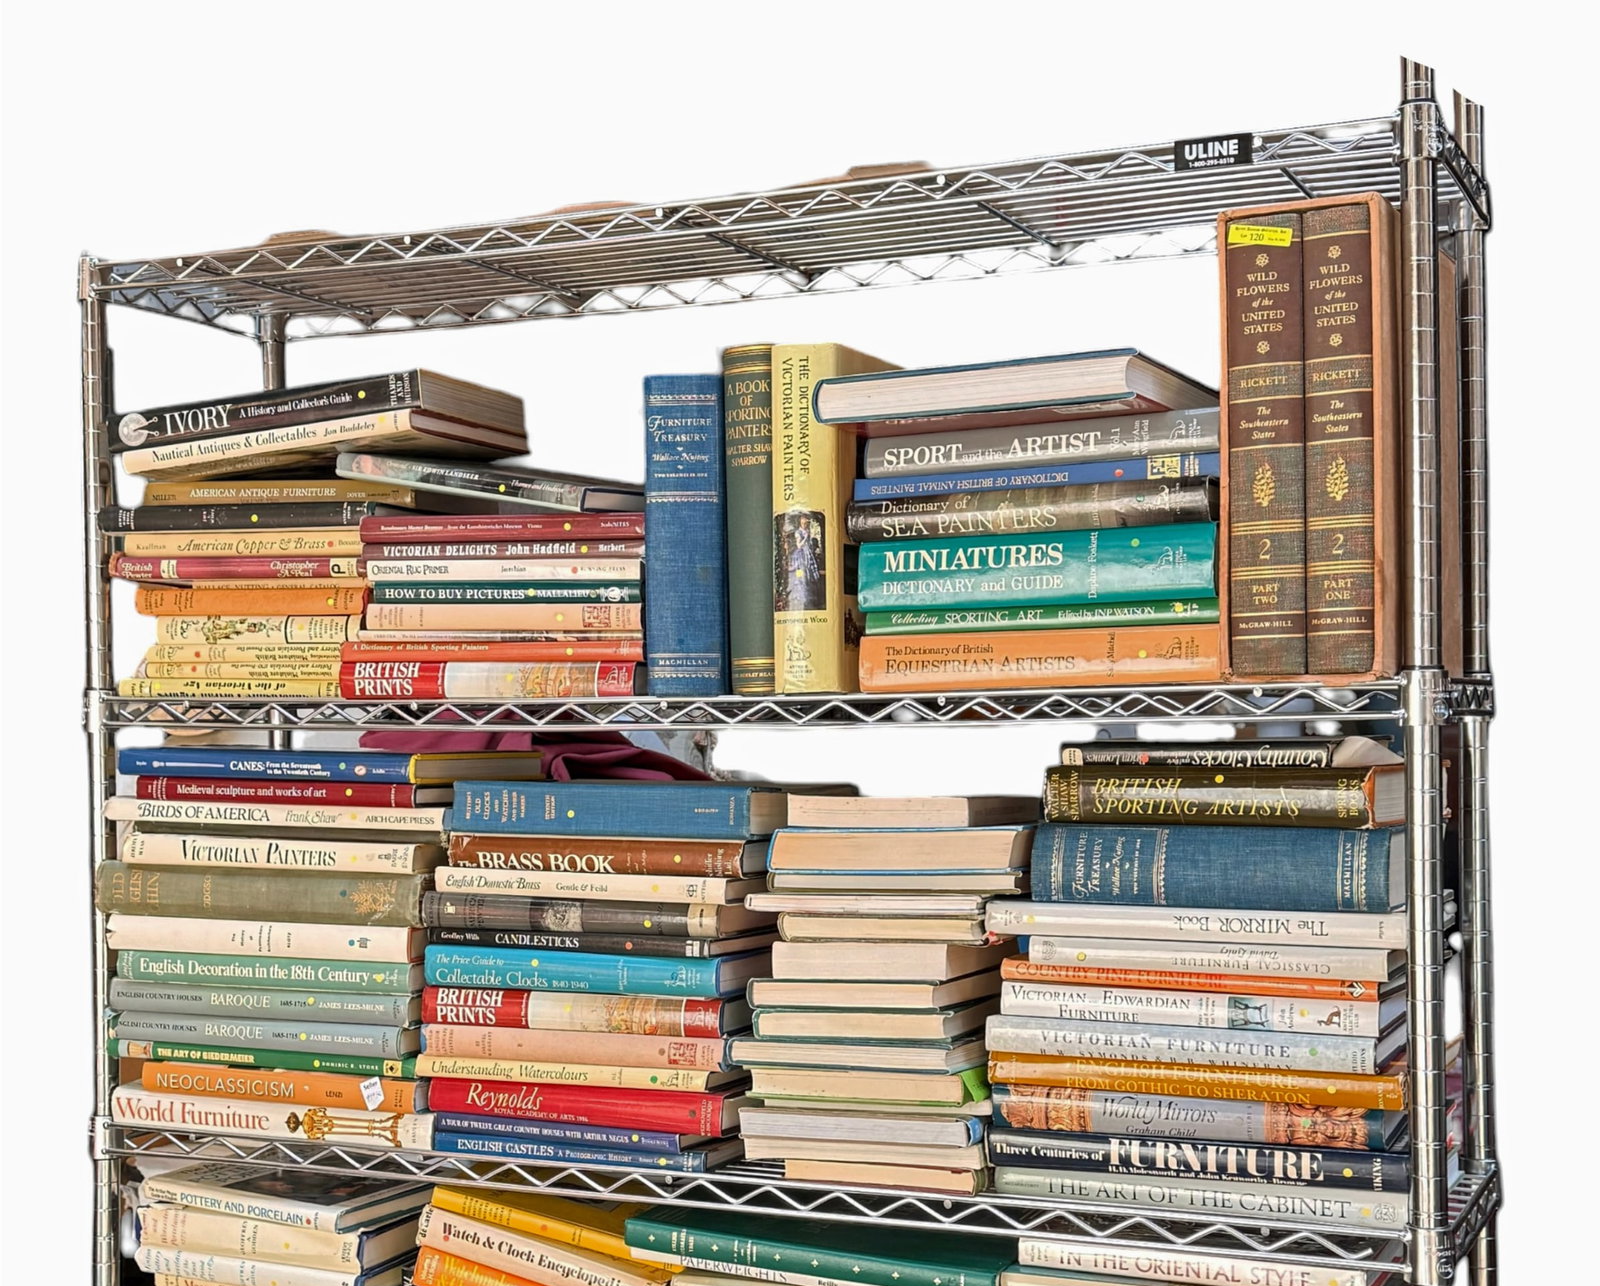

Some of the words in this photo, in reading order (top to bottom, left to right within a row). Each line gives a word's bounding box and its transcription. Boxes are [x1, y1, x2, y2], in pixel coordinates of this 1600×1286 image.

[1185, 139, 1239, 160] ULINE
[1250, 233, 1264, 241] 120
[1247, 272, 1278, 282] WILD
[1320, 264, 1350, 274] WILD
[1237, 283, 1290, 297] FLOWERS
[1309, 275, 1363, 289] FLOWERS
[1242, 310, 1285, 322] UNITED
[1315, 302, 1358, 314] UNITED
[1244, 323, 1283, 335] STATES
[1317, 315, 1356, 327] STATES
[799, 356, 809, 380] THE
[736, 380, 770, 393] BOOK
[782, 358, 793, 430] VICTORIAN
[740, 396, 753, 407] OF
[163, 404, 232, 436] IVORY
[799, 386, 810, 457] DICTIONARY
[152, 445, 194, 463] Nautical
[197, 440, 241, 460] Antiques
[244, 433, 253, 448] &
[256, 428, 317, 447] Collectables
[883, 444, 962, 467] SPORT
[1006, 431, 1101, 458] ARTIST
[783, 435, 795, 501] PAINTERS
[801, 458, 809, 474] OF
[190, 488, 236, 497] AMERICAN
[239, 488, 279, 497] ANTIQUE
[283, 488, 336, 497] FURNITURE
[177, 537, 233, 551] American
[236, 535, 276, 554] Copper
[279, 537, 292, 550] &
[294, 537, 326, 550] Brass
[883, 543, 1063, 573] MINIATURES
[882, 578, 974, 594] DICTIONARY
[981, 579, 1006, 591] and
[1011, 575, 1063, 590] GUIDE
[1252, 584, 1279, 593] PART
[1324, 579, 1353, 588] PART
[385, 589, 416, 599] HOW
[418, 589, 435, 599] TO
[438, 589, 463, 599] BUY
[466, 589, 526, 599] PICTURES
[1253, 595, 1278, 604] TWO
[1326, 591, 1351, 600] ONE
[354, 662, 420, 678] BRITISH
[354, 679, 413, 696] PRINTS
[177, 784, 214, 796] Medieval
[216, 786, 251, 797] sculpture
[253, 786, 272, 796] and
[274, 787, 298, 796] works
[300, 786, 309, 797] of
[311, 787, 326, 797] art
[1093, 777, 1182, 795] BRITISH
[138, 803, 182, 818] BIRDS
[186, 806, 203, 819] OF
[203, 807, 270, 821] AMERICA
[1094, 797, 1198, 816] SPORTING
[1205, 799, 1300, 817] ARTISTS
[181, 839, 259, 864] VICTORIAN
[266, 842, 336, 866] PAINTERS
[1173, 915, 1209, 929] Book
[1219, 918, 1293, 934] MIRROR
[1298, 922, 1328, 936] The
[495, 933, 579, 948] CANDLESTICKS
[139, 958, 184, 976] English
[188, 961, 253, 978] Decoration
[255, 964, 267, 978] in
[269, 964, 288, 979] the
[291, 964, 315, 981] 18th
[318, 964, 370, 985] Century
[435, 968, 501, 986] Collectable
[506, 971, 548, 987] Clocks
[210, 990, 271, 1008] BAROQUE
[205, 1024, 263, 1039] BAROQUE
[432, 1061, 513, 1079] Understanding
[519, 1064, 589, 1081] Watercolours
[156, 1072, 295, 1098] NEOCLASSICISM
[466, 1082, 543, 1111] Reynolds
[117, 1096, 174, 1123] World
[180, 1102, 270, 1131] Furniture
[993, 1142, 1029, 1157] Three
[1031, 1145, 1091, 1161] Centuries
[1093, 1148, 1106, 1161] of
[1108, 1138, 1324, 1181] FURNITURE
[180, 1193, 222, 1209] POTTERY
[224, 1202, 244, 1214] AND
[248, 1206, 303, 1224] PORCELAIN
[442, 1222, 481, 1245] Watch
[483, 1236, 495, 1249] &
[497, 1240, 535, 1263] Clock
